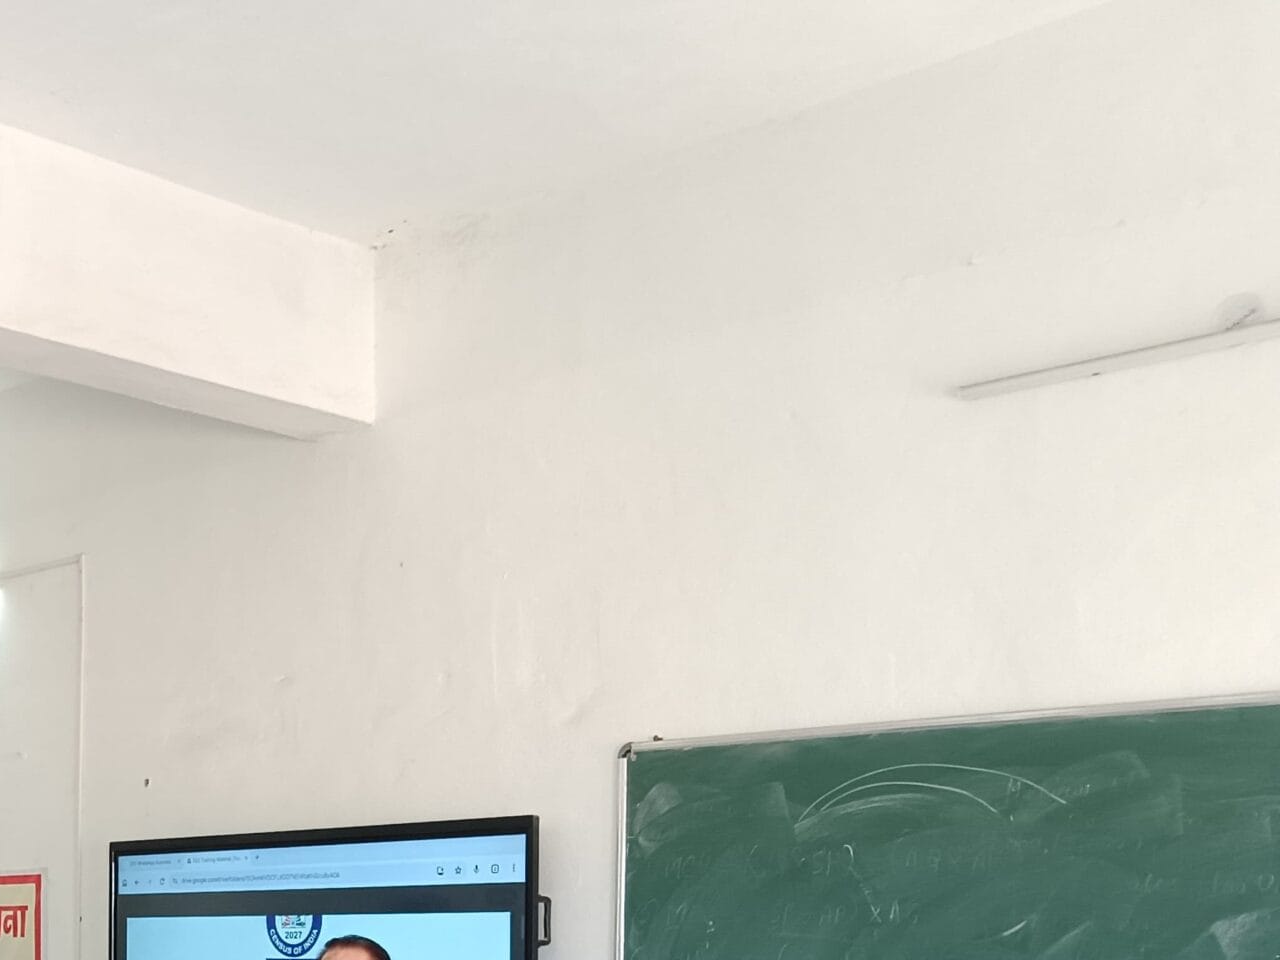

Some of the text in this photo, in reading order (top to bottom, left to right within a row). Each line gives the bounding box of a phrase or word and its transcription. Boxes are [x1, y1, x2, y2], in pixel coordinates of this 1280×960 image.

[270, 929, 292, 955] CENSUS
[303, 929, 319, 950] INDIA
[284, 931, 302, 940] 2027
